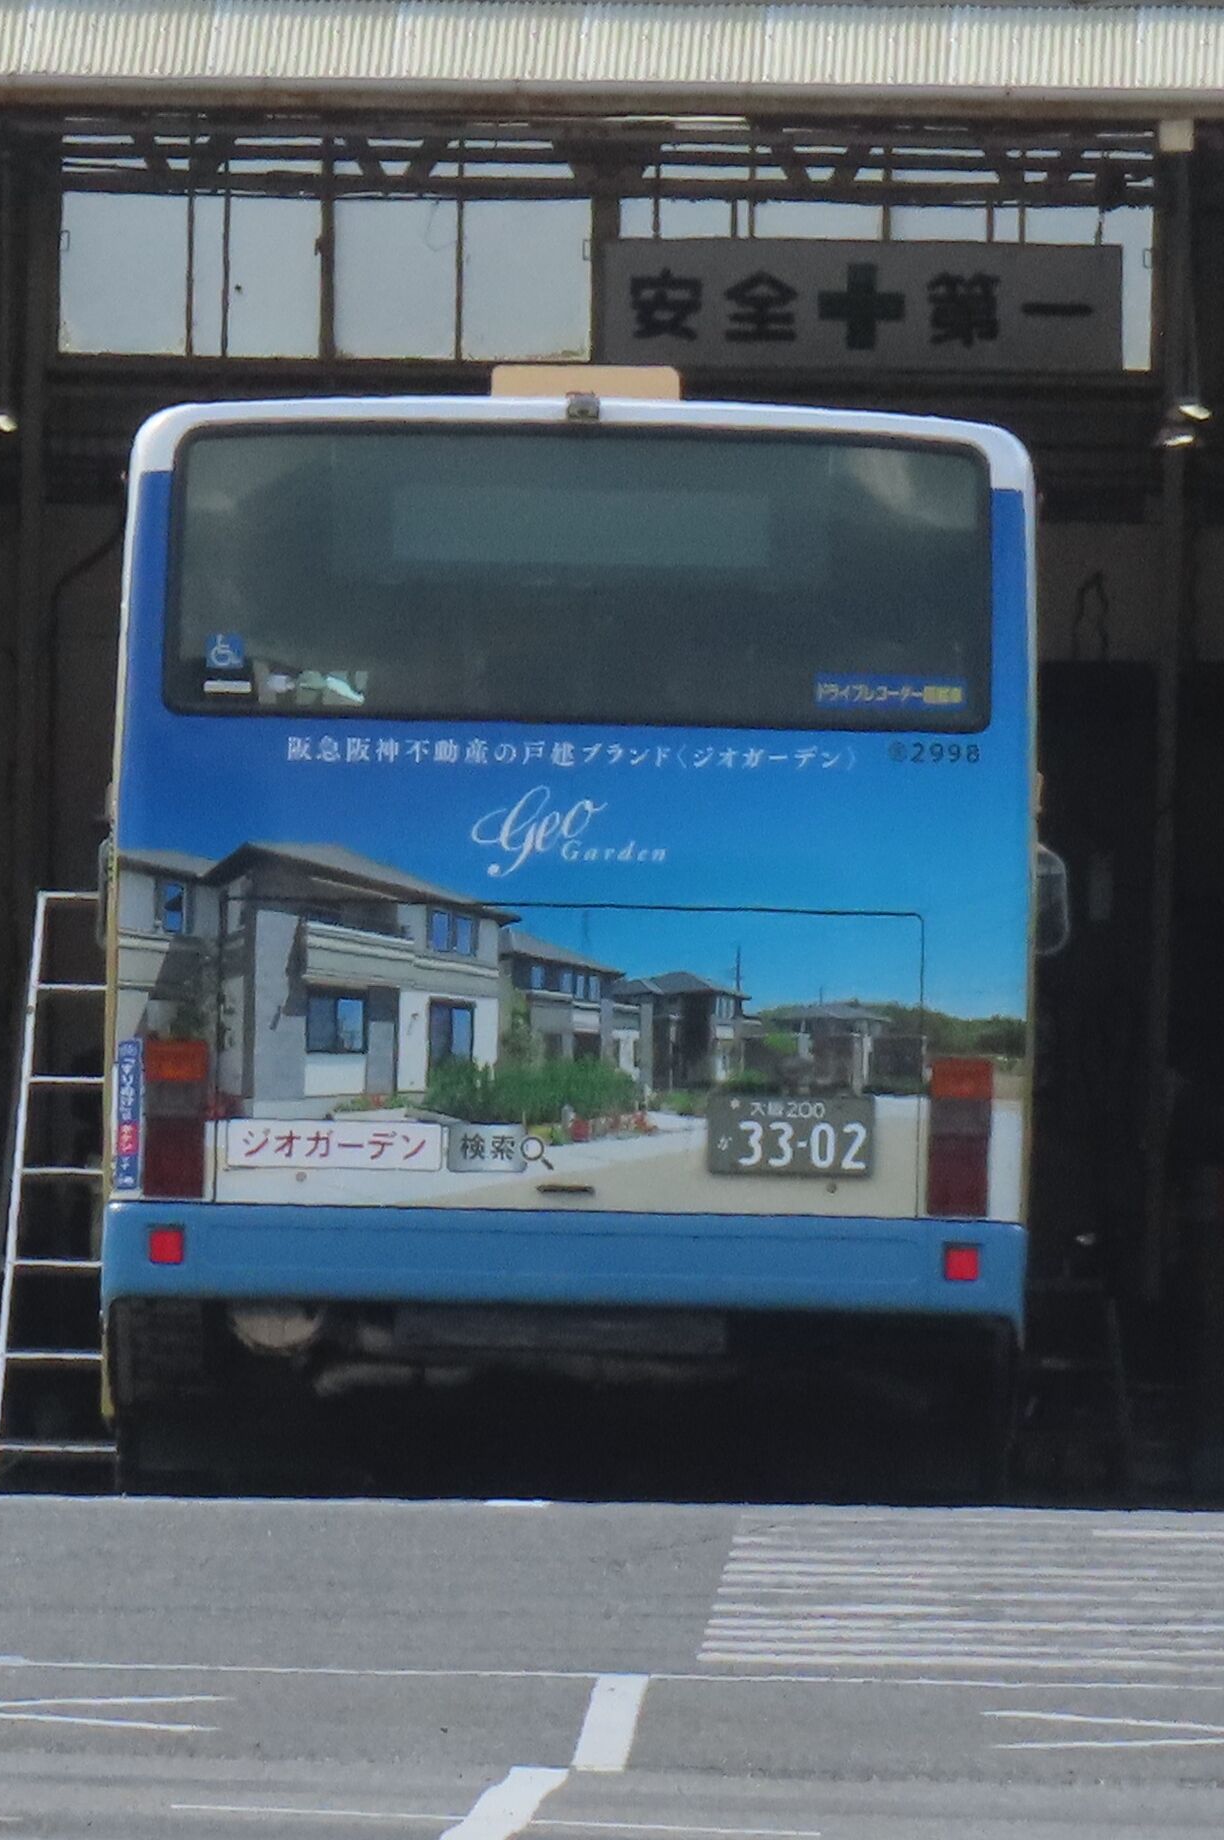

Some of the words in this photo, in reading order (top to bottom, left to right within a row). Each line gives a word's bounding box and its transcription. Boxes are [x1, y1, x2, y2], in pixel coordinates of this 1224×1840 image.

[561, 838, 666, 862] Garden
[242, 1127, 427, 1161] ジオガーデン
[459, 1132, 520, 1162] 検索
[738, 1119, 868, 1170] 33-02
